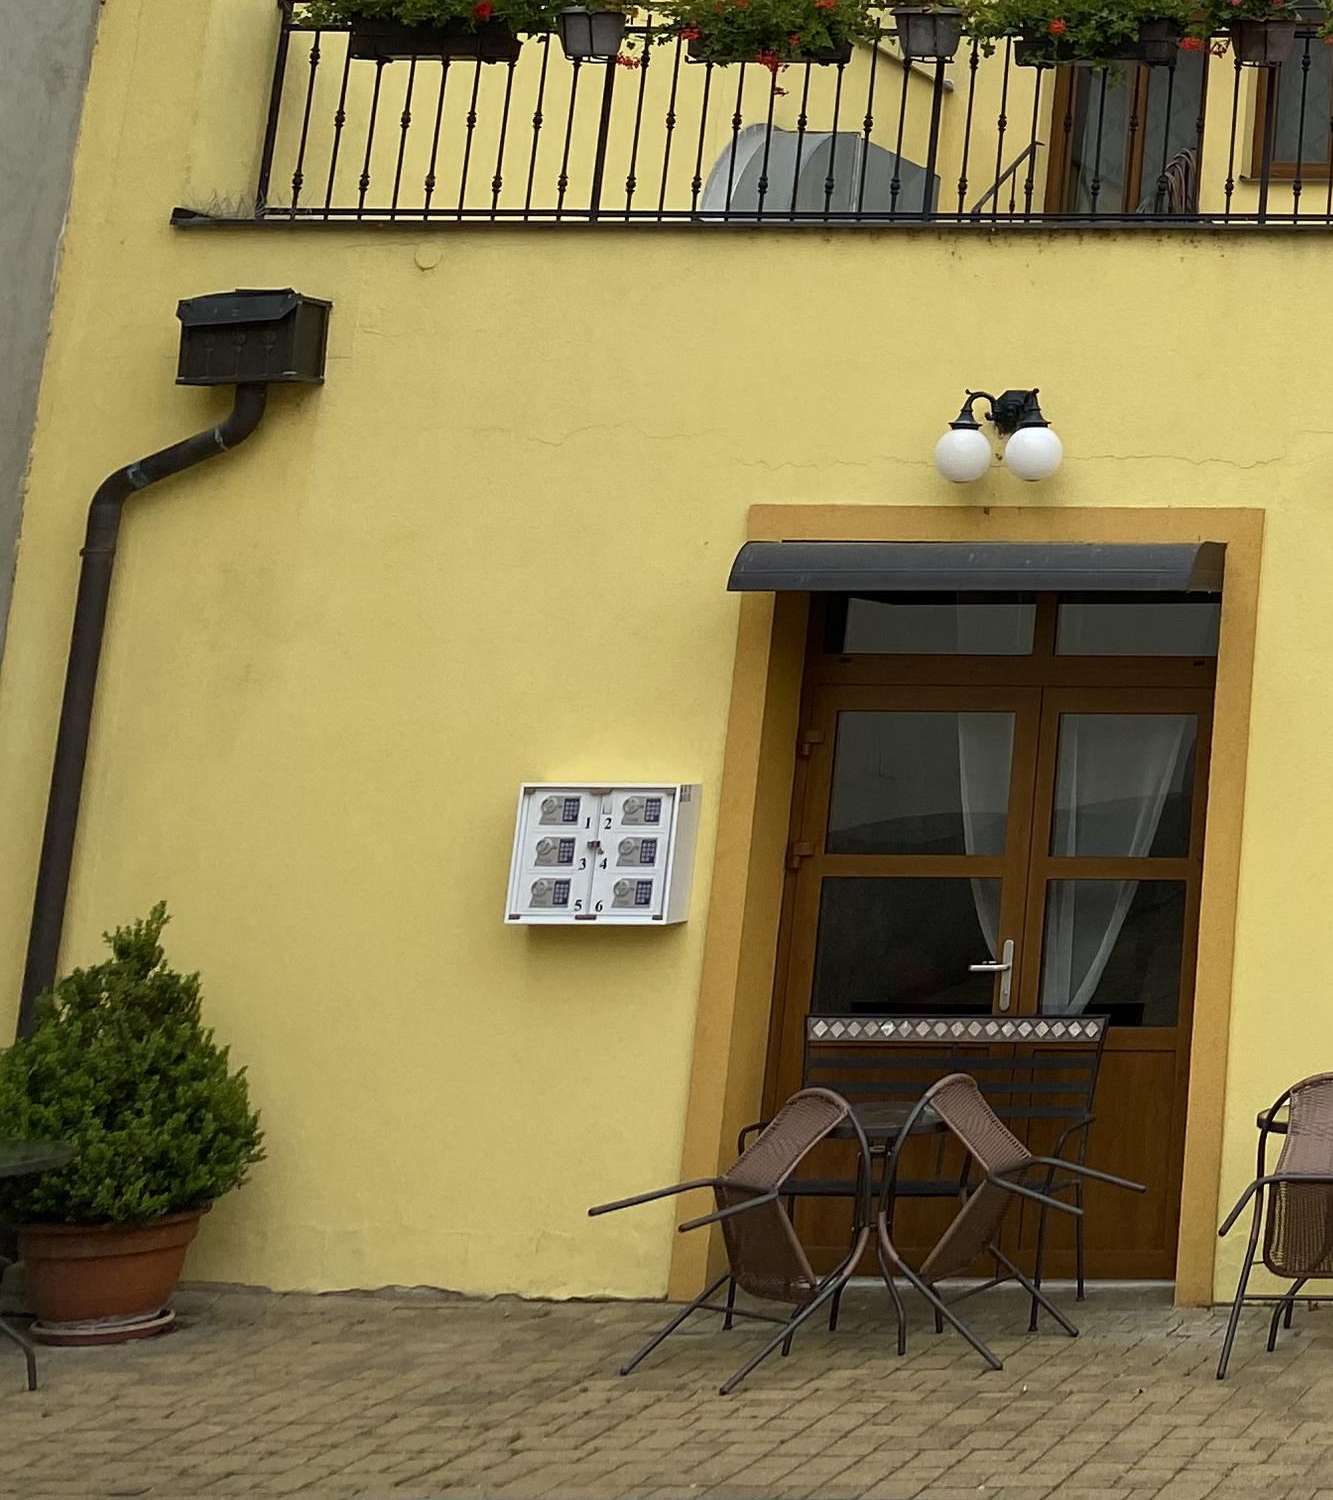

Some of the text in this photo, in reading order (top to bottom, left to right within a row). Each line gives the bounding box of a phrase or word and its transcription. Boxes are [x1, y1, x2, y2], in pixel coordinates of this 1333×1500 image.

[584, 816, 591, 830] 1
[603, 817, 612, 830] 2
[577, 857, 587, 871] 3
[599, 857, 608, 870] 4
[573, 899, 583, 912] 5
[594, 899, 604, 912] 6
